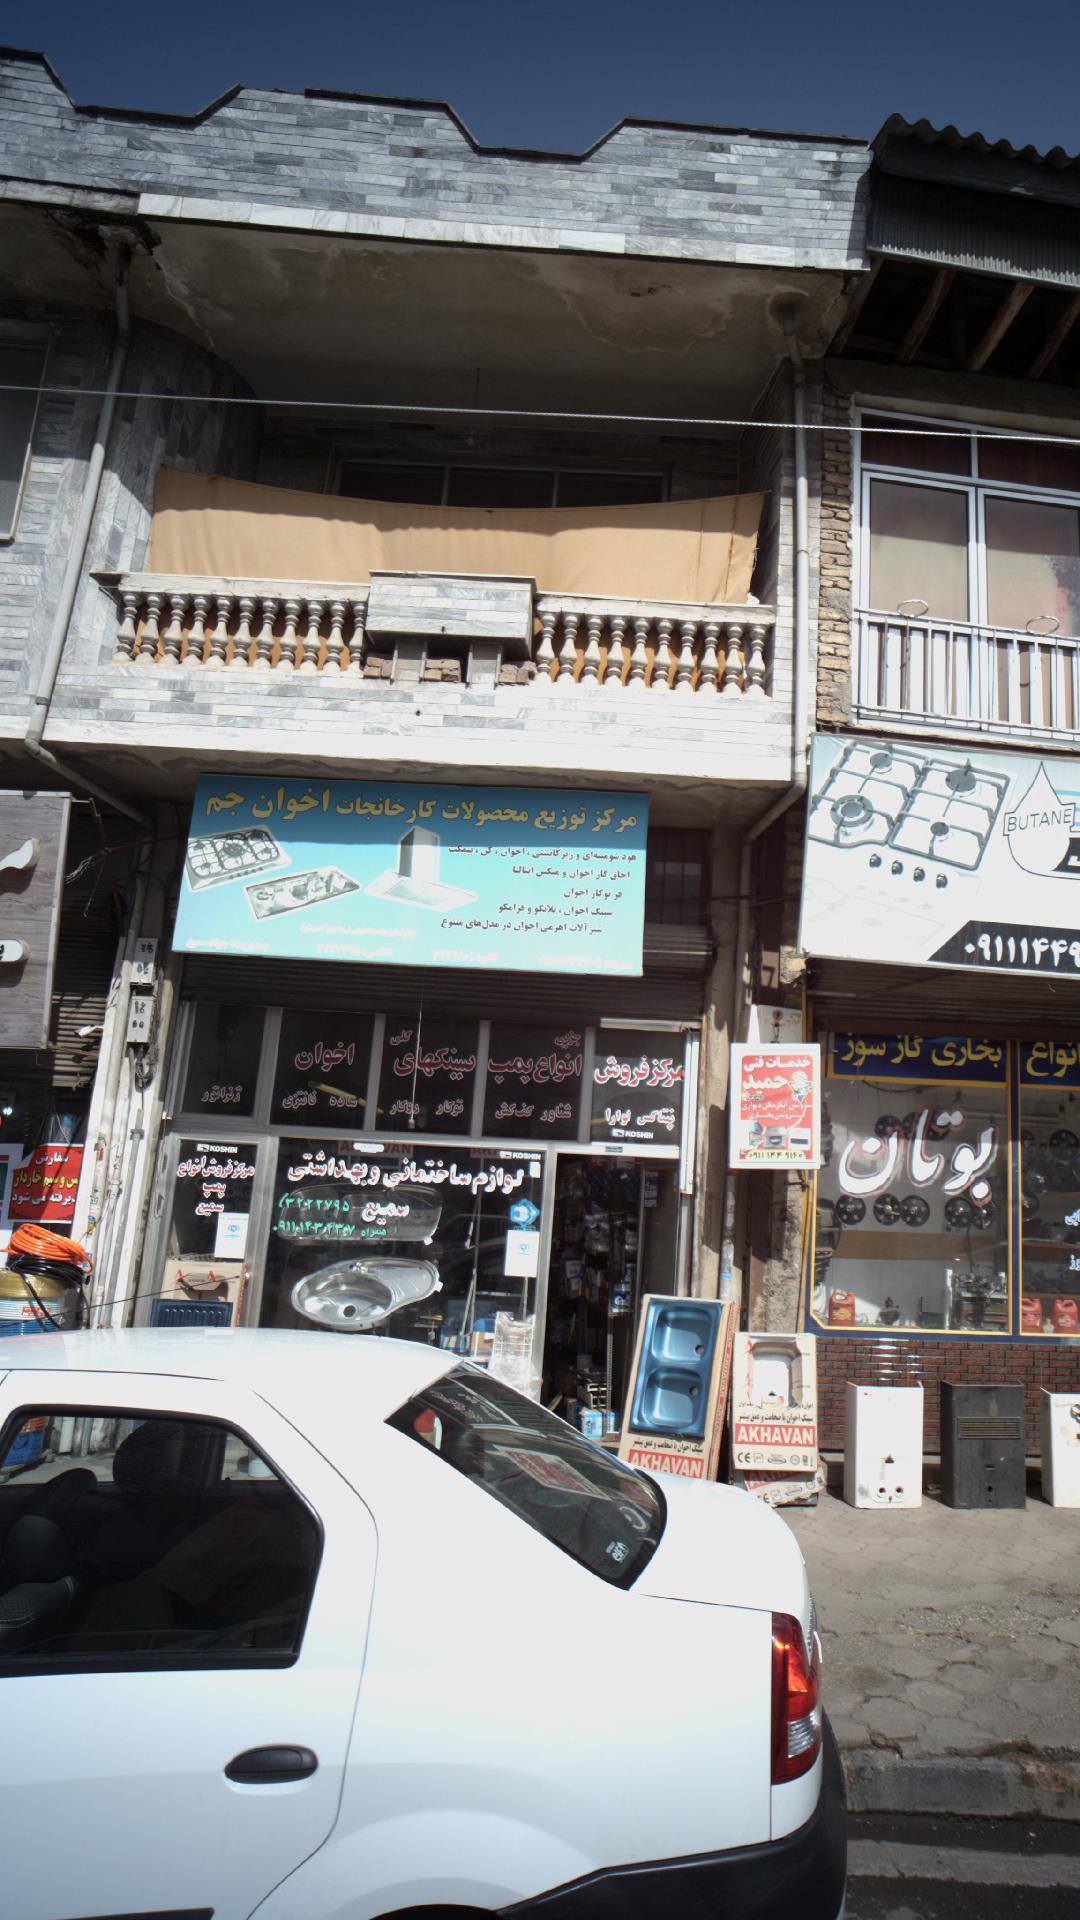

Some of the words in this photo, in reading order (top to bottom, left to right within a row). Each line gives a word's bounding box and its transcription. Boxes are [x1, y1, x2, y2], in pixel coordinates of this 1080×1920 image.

[206, 790, 245, 816] جم
[251, 787, 331, 820] اخوان
[441, 800, 529, 827] محصولات
[534, 807, 586, 832] توزیع
[591, 807, 637, 833] مرکز
[1007, 808, 1073, 832] BUTANE
[294, 1040, 356, 1072] اخوان
[841, 1033, 887, 1067] سوز
[891, 1034, 923, 1063] گاز
[931, 1037, 1002, 1068] بخاری
[487, 1057, 533, 1085] پمپ
[532, 1052, 583, 1083] انواع
[594, 1055, 650, 1087] فروش
[646, 1059, 685, 1087] مرکز
[201, 1085, 244, 1103] ژنراتور
[435, 1099, 465, 1117] توکار
[539, 1102, 572, 1122] شناور
[624, 1130, 654, 1140] KOSHIN
[209, 1145, 238, 1154] KOSHIN
[512, 1151, 541, 1160] KOSHIN
[839, 1107, 997, 1202] بوتان
[176, 1155, 207, 1178] انواع
[201, 1157, 233, 1178] فروش
[231, 1160, 256, 1179] مرکز
[288, 1150, 368, 1186] بهداشتی
[370, 1166, 381, 1186] و
[382, 1156, 472, 1188] ساختمانی
[202, 1182, 226, 1198] پمپ
[471, 1165, 525, 1195] لوازم
[737, 1425, 814, 1445] AKHAVAN
[631, 1450, 702, 1478] AKHAVAN
